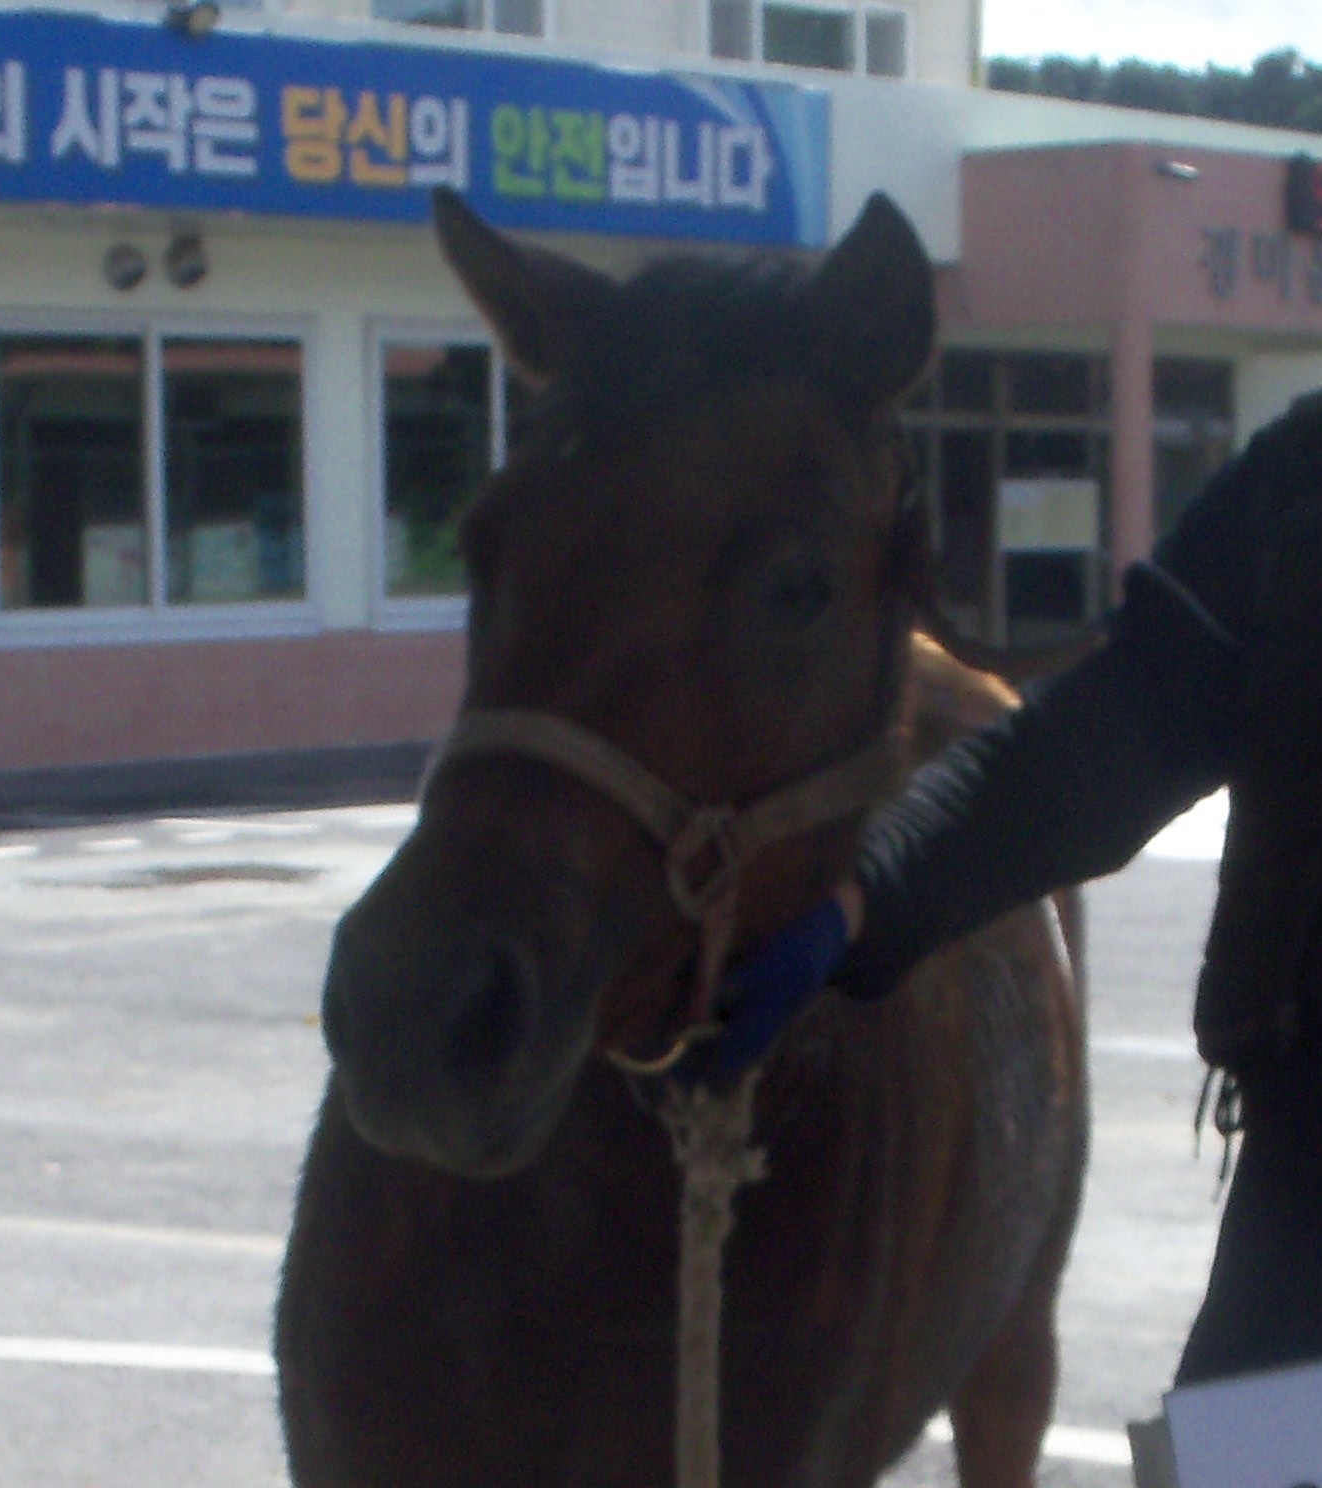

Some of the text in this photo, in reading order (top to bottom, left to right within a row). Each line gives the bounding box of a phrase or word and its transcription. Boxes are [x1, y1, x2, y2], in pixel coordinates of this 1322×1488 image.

[49, 64, 259, 176] 시작은
[281, 86, 471, 190] 당신의
[491, 108, 775, 212] 안전입니다
